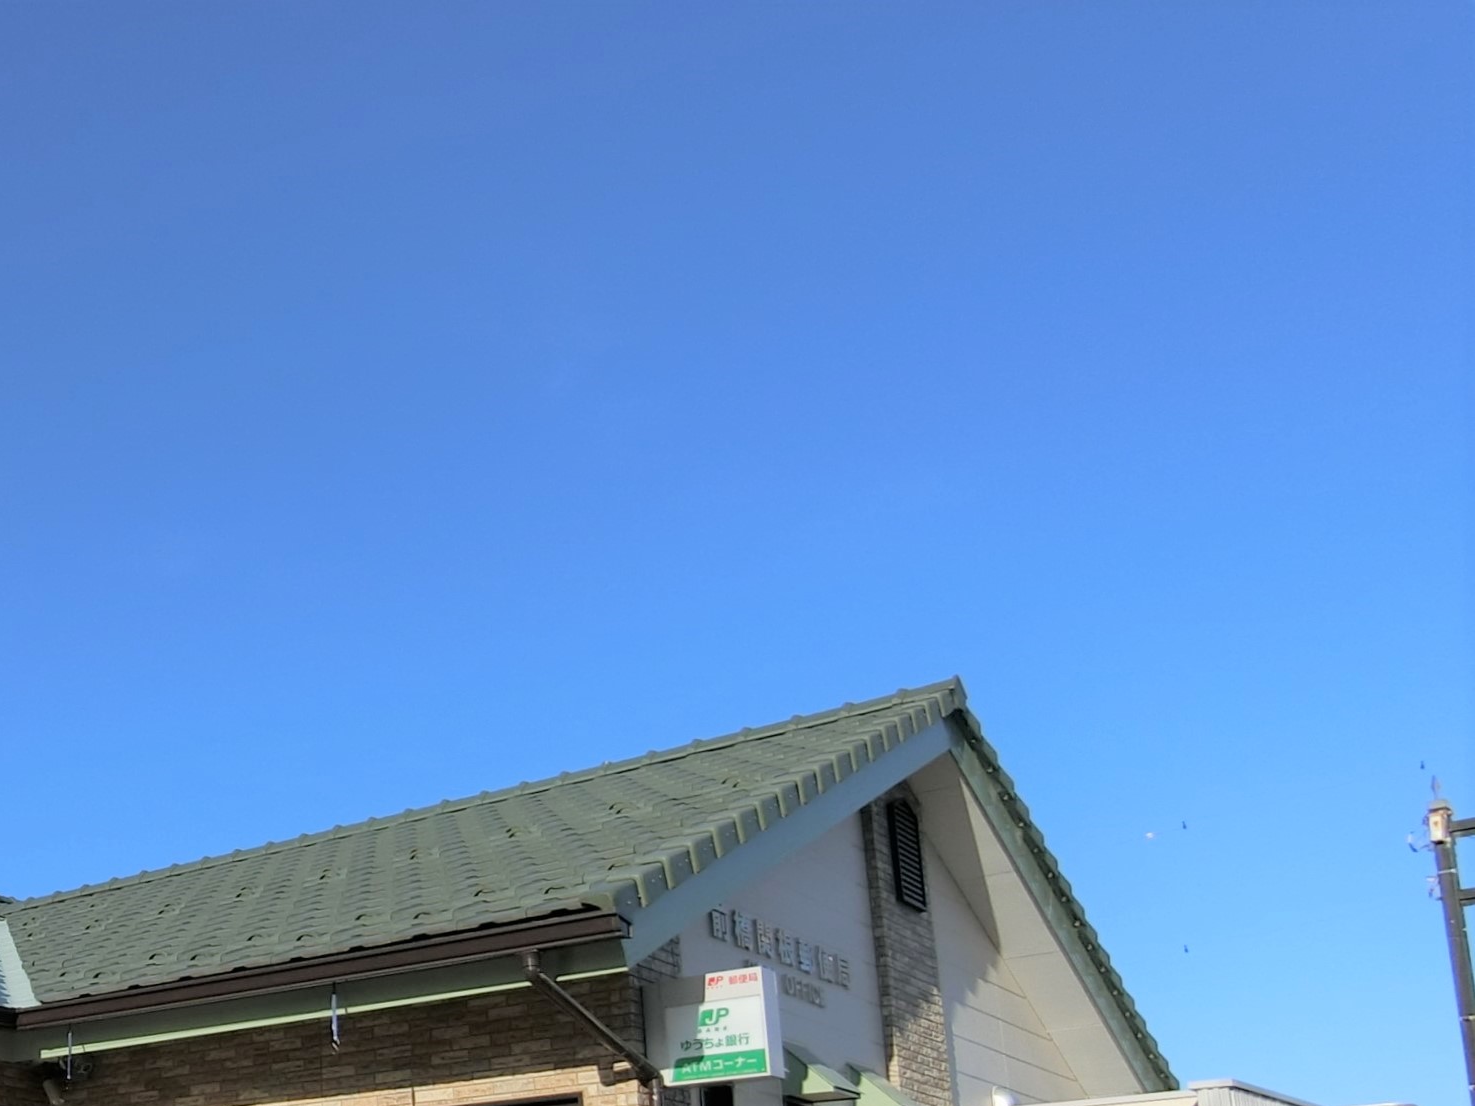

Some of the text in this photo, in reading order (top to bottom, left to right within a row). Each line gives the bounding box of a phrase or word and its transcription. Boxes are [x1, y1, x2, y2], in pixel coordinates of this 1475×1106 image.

[680, 1033, 750, 1052] ゆうちょ銀行
[681, 1056, 758, 1075] ATMコーナー
